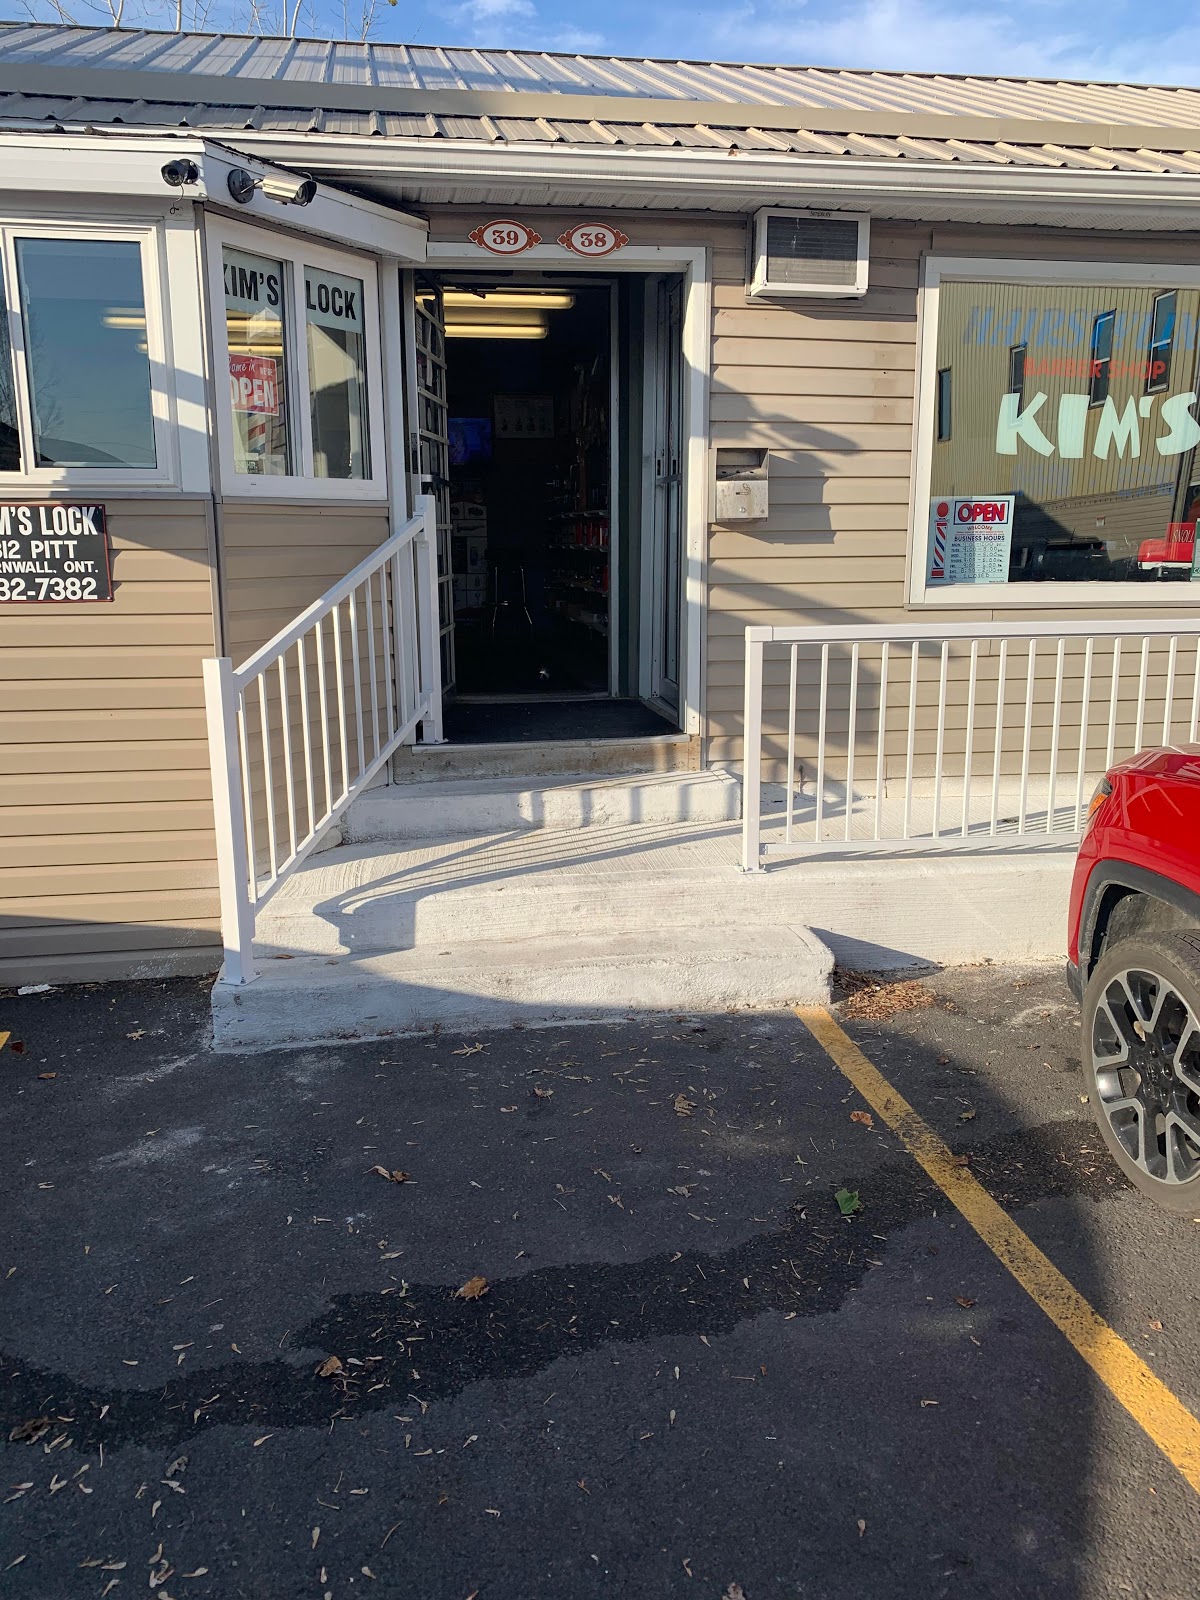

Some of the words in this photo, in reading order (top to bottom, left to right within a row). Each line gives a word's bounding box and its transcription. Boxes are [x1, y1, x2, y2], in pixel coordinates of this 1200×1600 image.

[492, 229, 519, 246] 39
[580, 232, 607, 248] 38
[305, 280, 356, 320] LOCK
[1023, 357, 1102, 378] BARBER
[1107, 360, 1166, 380] SHOP
[996, 391, 1200, 461] KIM'S
[39, 506, 98, 536] LOCK
[957, 503, 1006, 522] OPEN
[30, 540, 78, 559] PITT
[63, 561, 99, 573] ONT.
